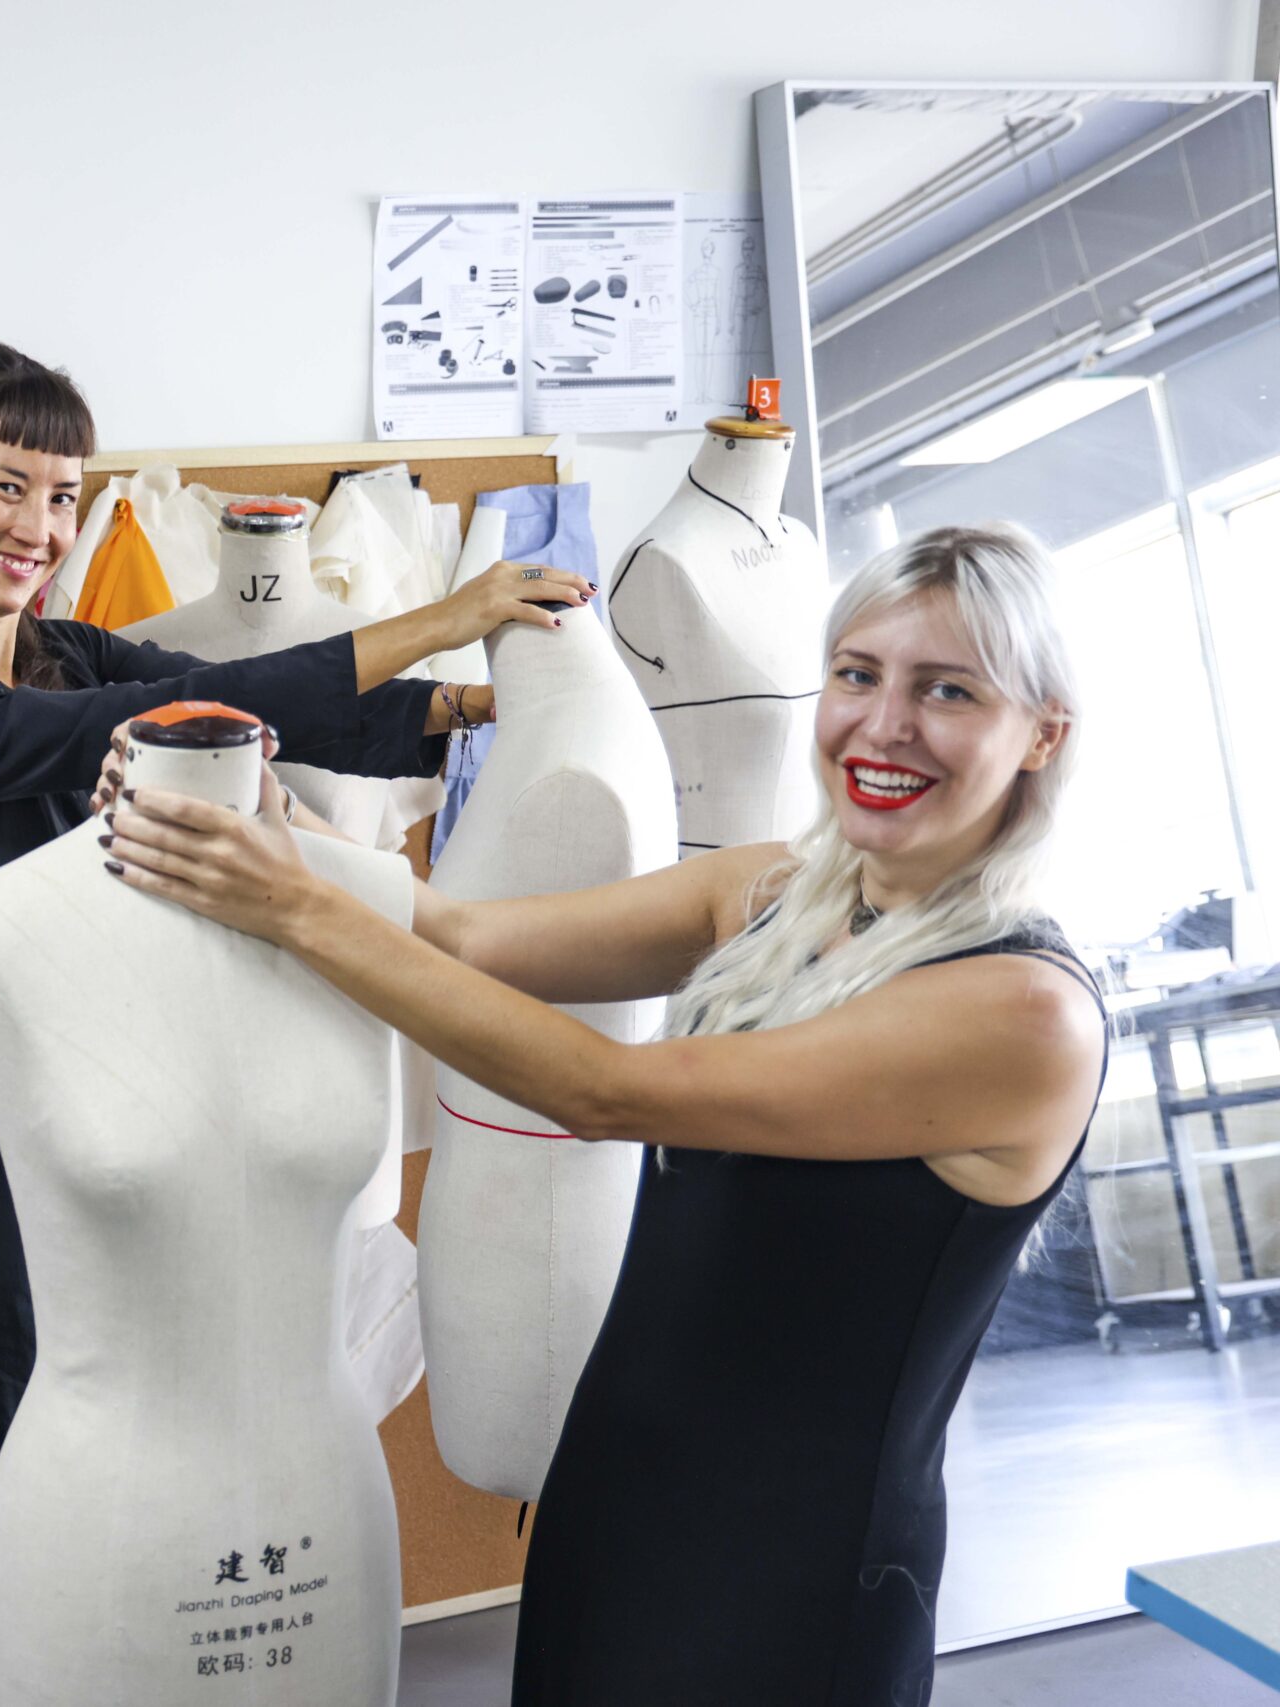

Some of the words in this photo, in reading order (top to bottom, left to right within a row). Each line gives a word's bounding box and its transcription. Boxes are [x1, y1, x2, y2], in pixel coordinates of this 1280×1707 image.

[758, 386, 772, 409] 3
[239, 574, 282, 603] JZ
[174, 1597, 224, 1614] Jianzhi
[230, 1588, 284, 1609] Draping
[289, 1575, 328, 1596] Model
[265, 1645, 294, 1669] 38
